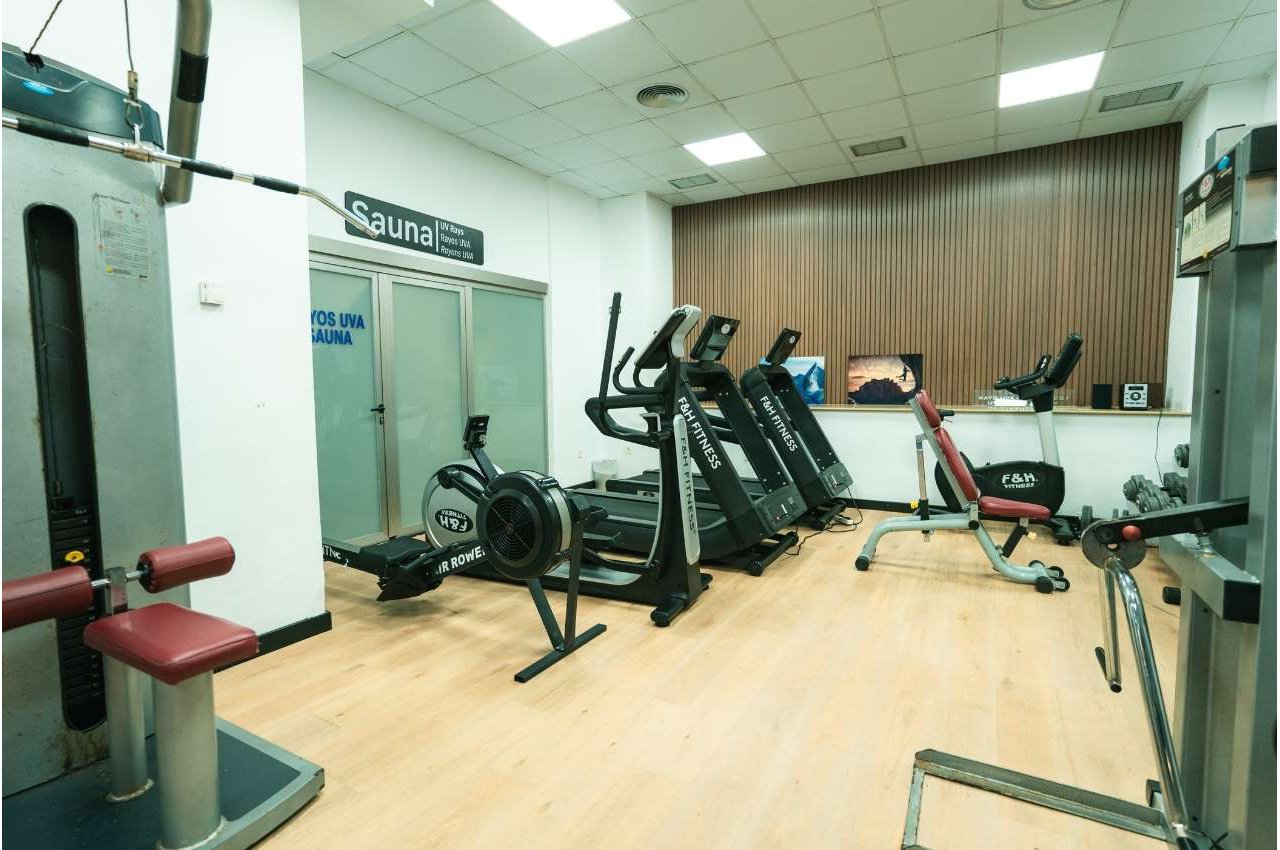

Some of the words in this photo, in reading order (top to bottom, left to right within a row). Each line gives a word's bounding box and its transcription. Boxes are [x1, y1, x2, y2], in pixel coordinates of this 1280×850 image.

[351, 200, 434, 248] Sauna
[459, 238, 471, 249] UVA
[339, 313, 365, 329] UVA
[677, 396, 696, 422] F&H
[692, 421, 722, 470] FITNESS
[760, 395, 776, 416] F&H
[772, 414, 798, 452] FITNESS
[1002, 472, 1035, 484] F&H
[684, 471, 696, 531] FITNESS
[439, 515, 468, 532] F&H
